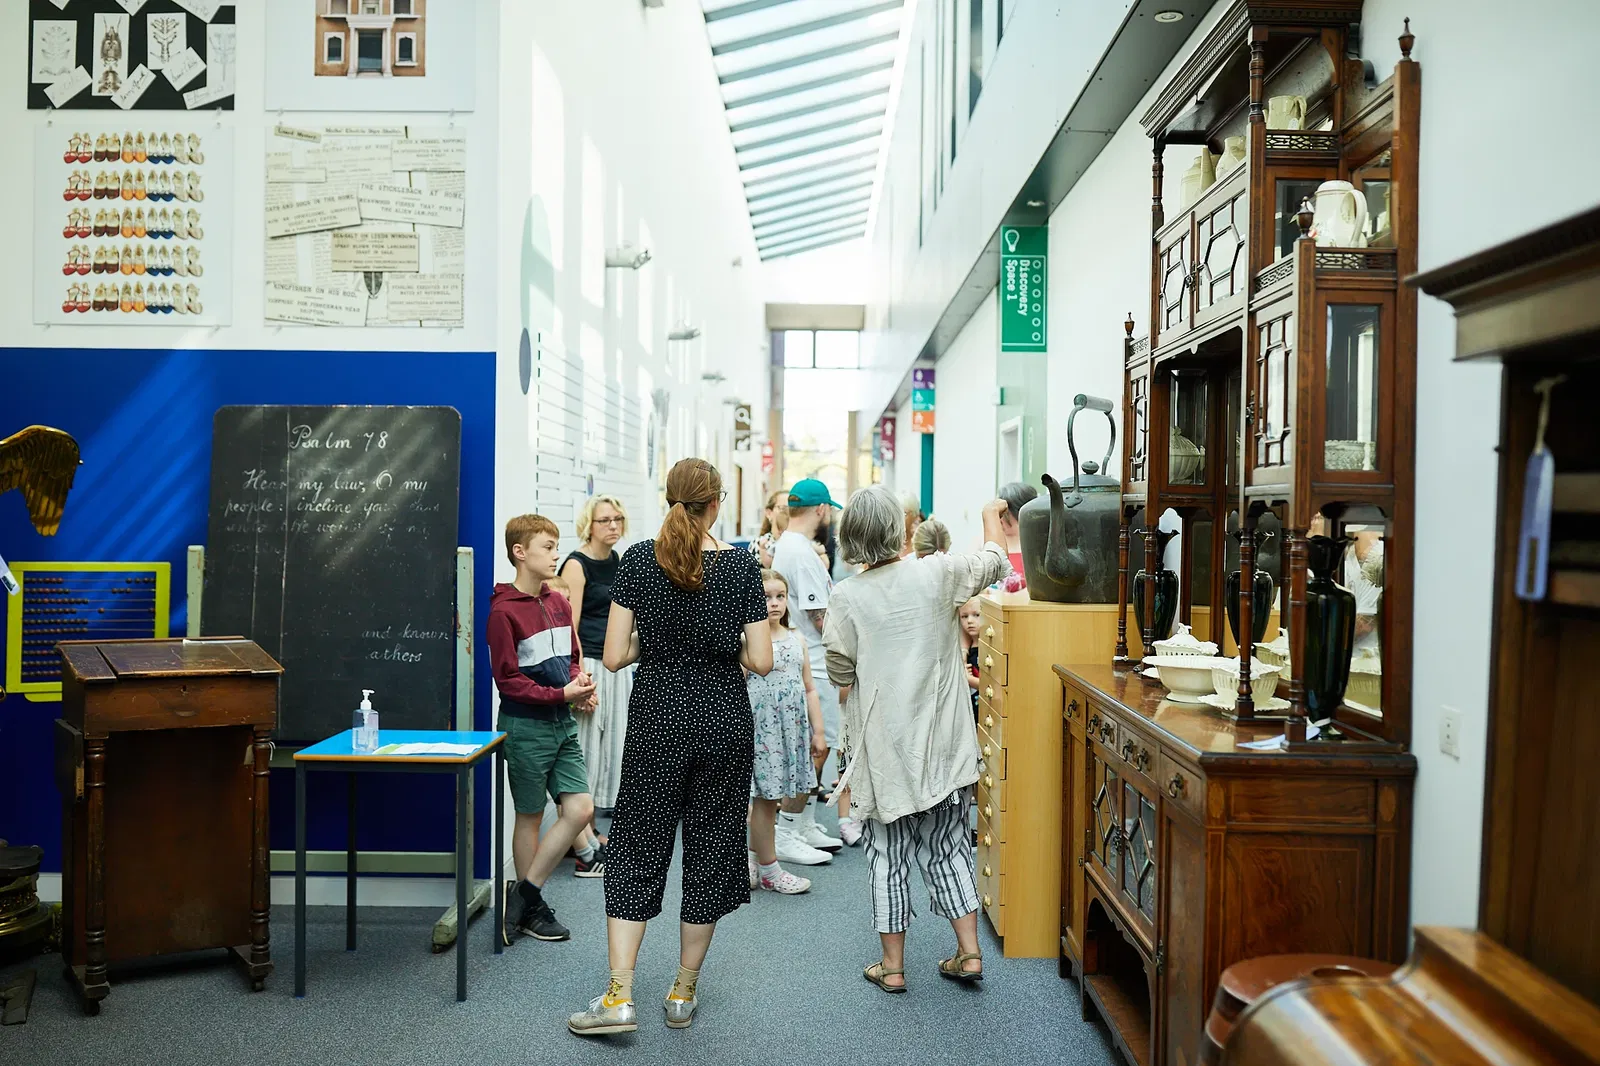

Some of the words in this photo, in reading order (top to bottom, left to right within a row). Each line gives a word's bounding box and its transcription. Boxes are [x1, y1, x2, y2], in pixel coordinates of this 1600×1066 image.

[323, 195, 336, 203] THE
[361, 183, 375, 191] THE
[429, 189, 439, 197] AT
[1005, 259, 1018, 292] Space
[315, 285, 325, 294] ON
[1017, 259, 1031, 316] Discovery
[289, 424, 352, 452] Psalm
[363, 430, 389, 450] 78
[242, 468, 288, 492] Hear
[298, 481, 325, 503] my
[374, 469, 393, 491] O
[403, 481, 429, 504] my
[297, 497, 352, 514] incline
[361, 625, 392, 640] and
[401, 622, 450, 641] known
